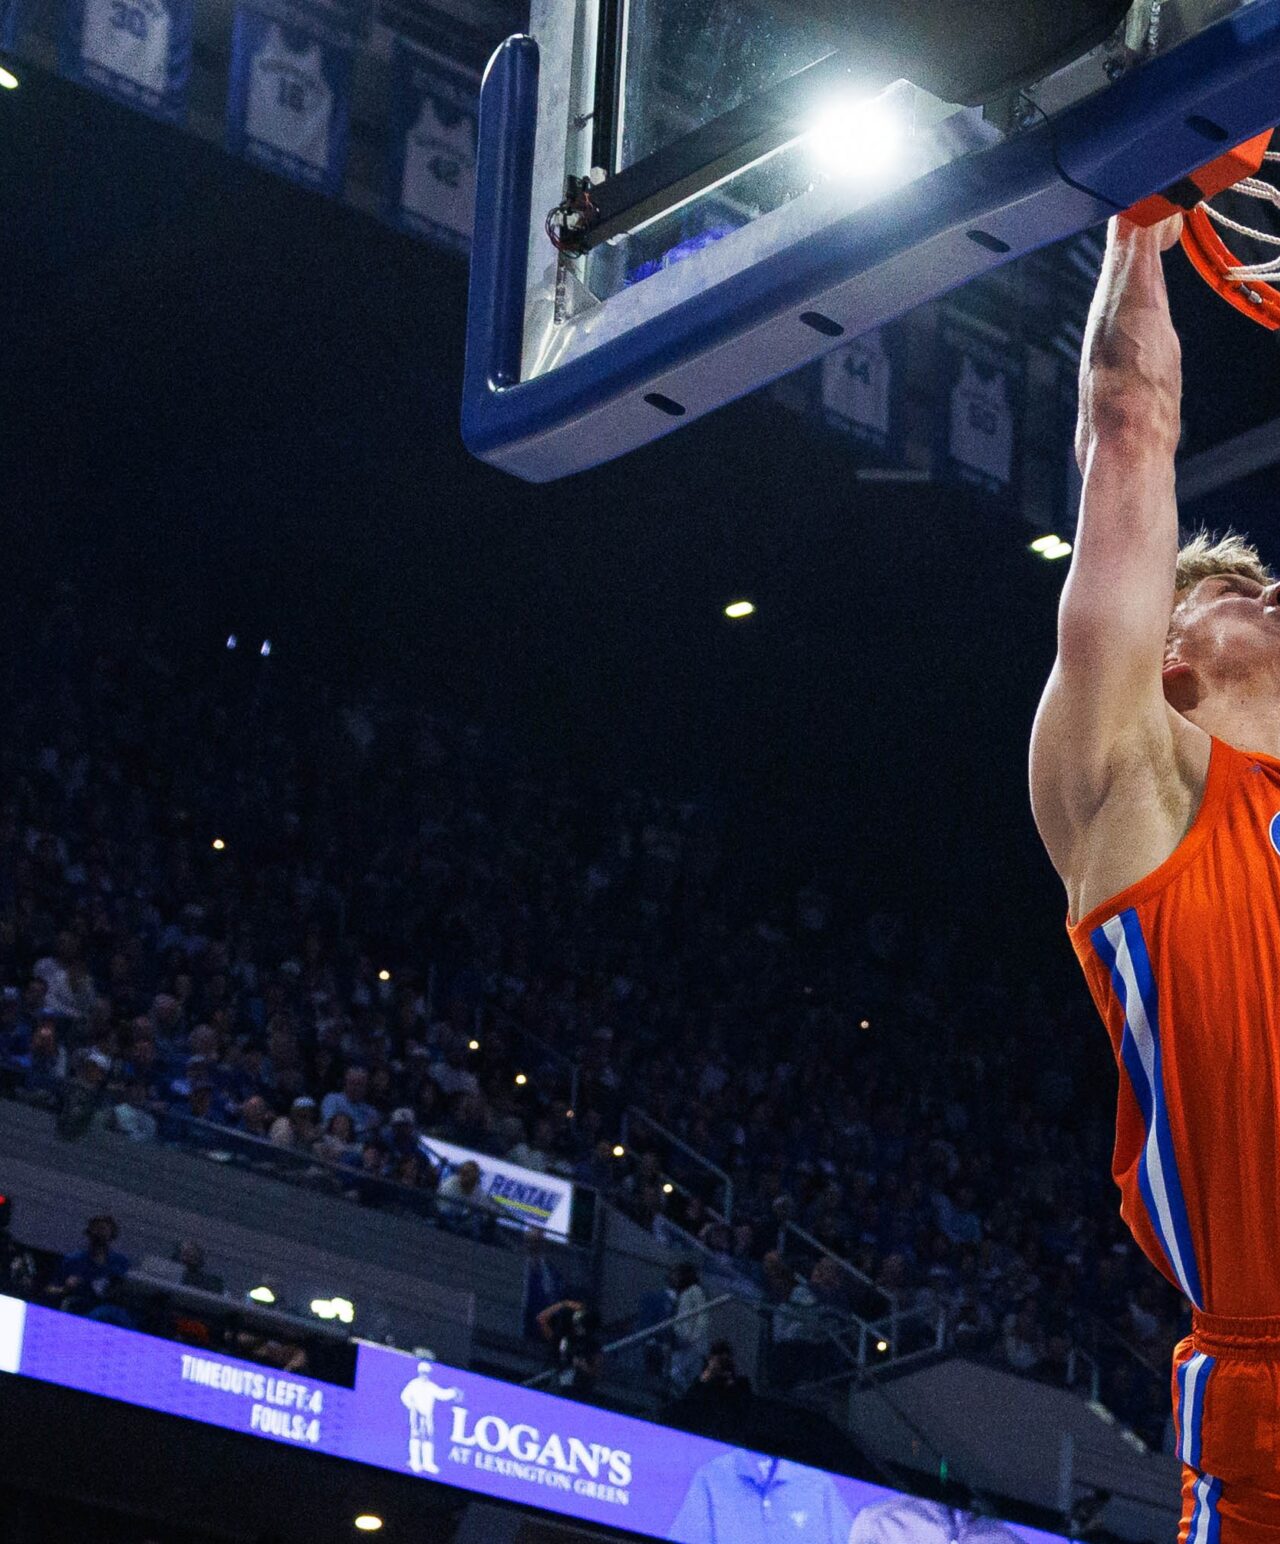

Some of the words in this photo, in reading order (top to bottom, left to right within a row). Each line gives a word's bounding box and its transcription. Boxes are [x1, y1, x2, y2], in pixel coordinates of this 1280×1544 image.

[180, 1353, 266, 1400] TIMEOUTS
[448, 1446, 472, 1465] AT
[474, 1452, 572, 1491] LEXINGTON
[574, 1478, 629, 1505] GREEN
[450, 1406, 632, 1487] LOGAN'S
